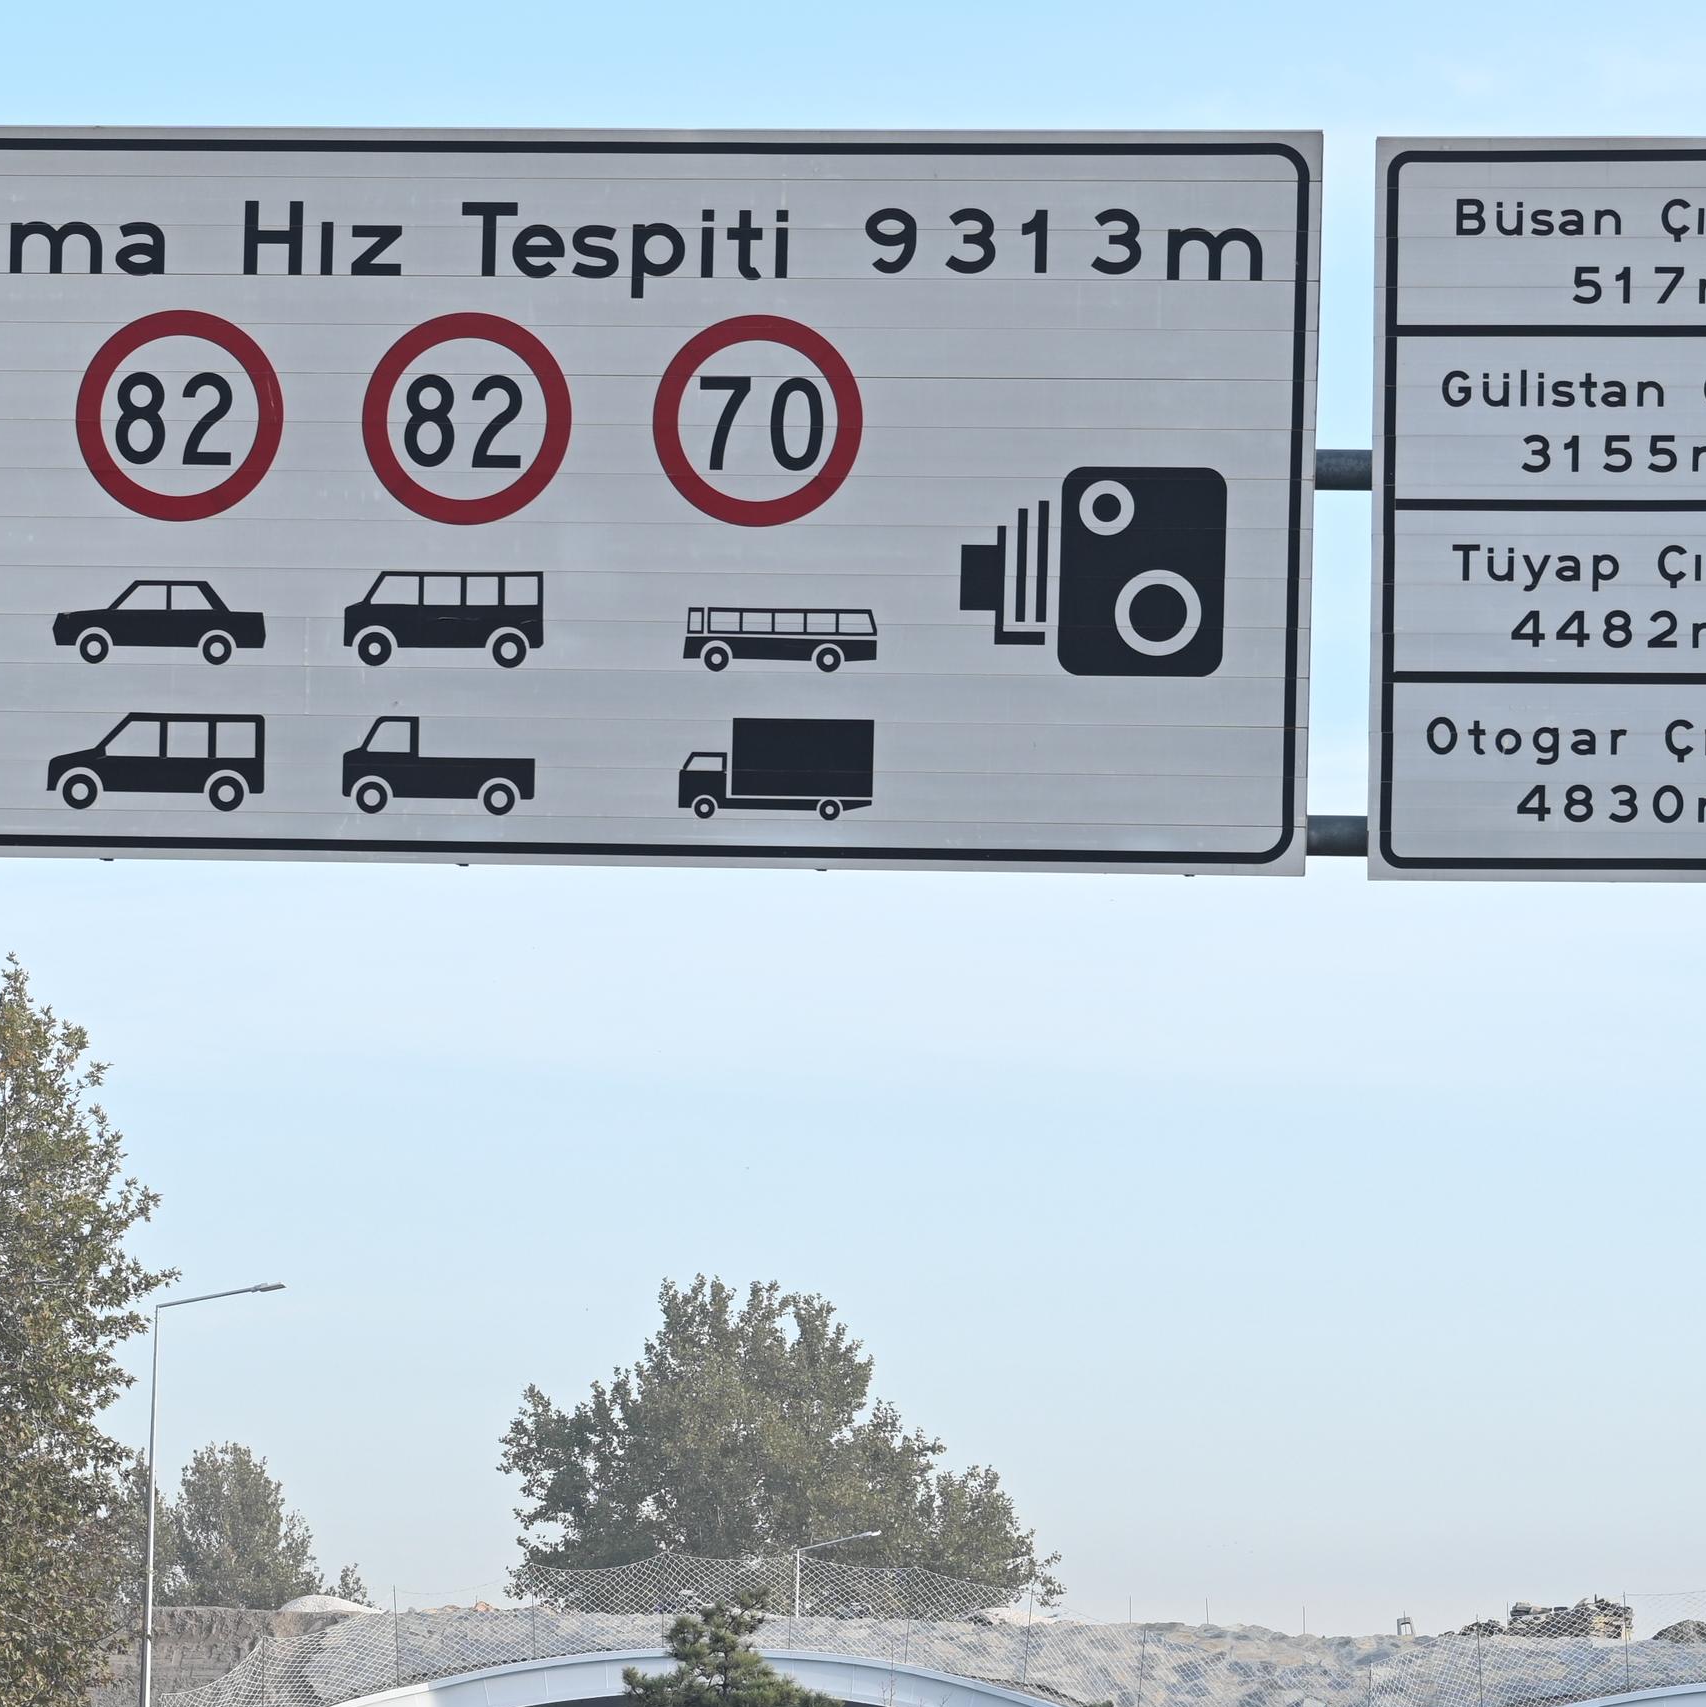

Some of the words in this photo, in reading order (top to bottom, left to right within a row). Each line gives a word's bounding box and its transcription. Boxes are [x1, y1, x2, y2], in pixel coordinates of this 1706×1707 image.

[242, 200, 403, 277] Hız
[461, 201, 789, 298] Tespiti
[864, 207, 1263, 282] 9313m
[1455, 198, 1622, 237] Büsan
[114, 371, 235, 468] 82
[403, 372, 524, 471] 82
[699, 375, 827, 473] 70
[1441, 369, 1665, 408] Gülistan
[1452, 544, 1620, 592] Tüyap
[1426, 716, 1628, 766] Otogar
